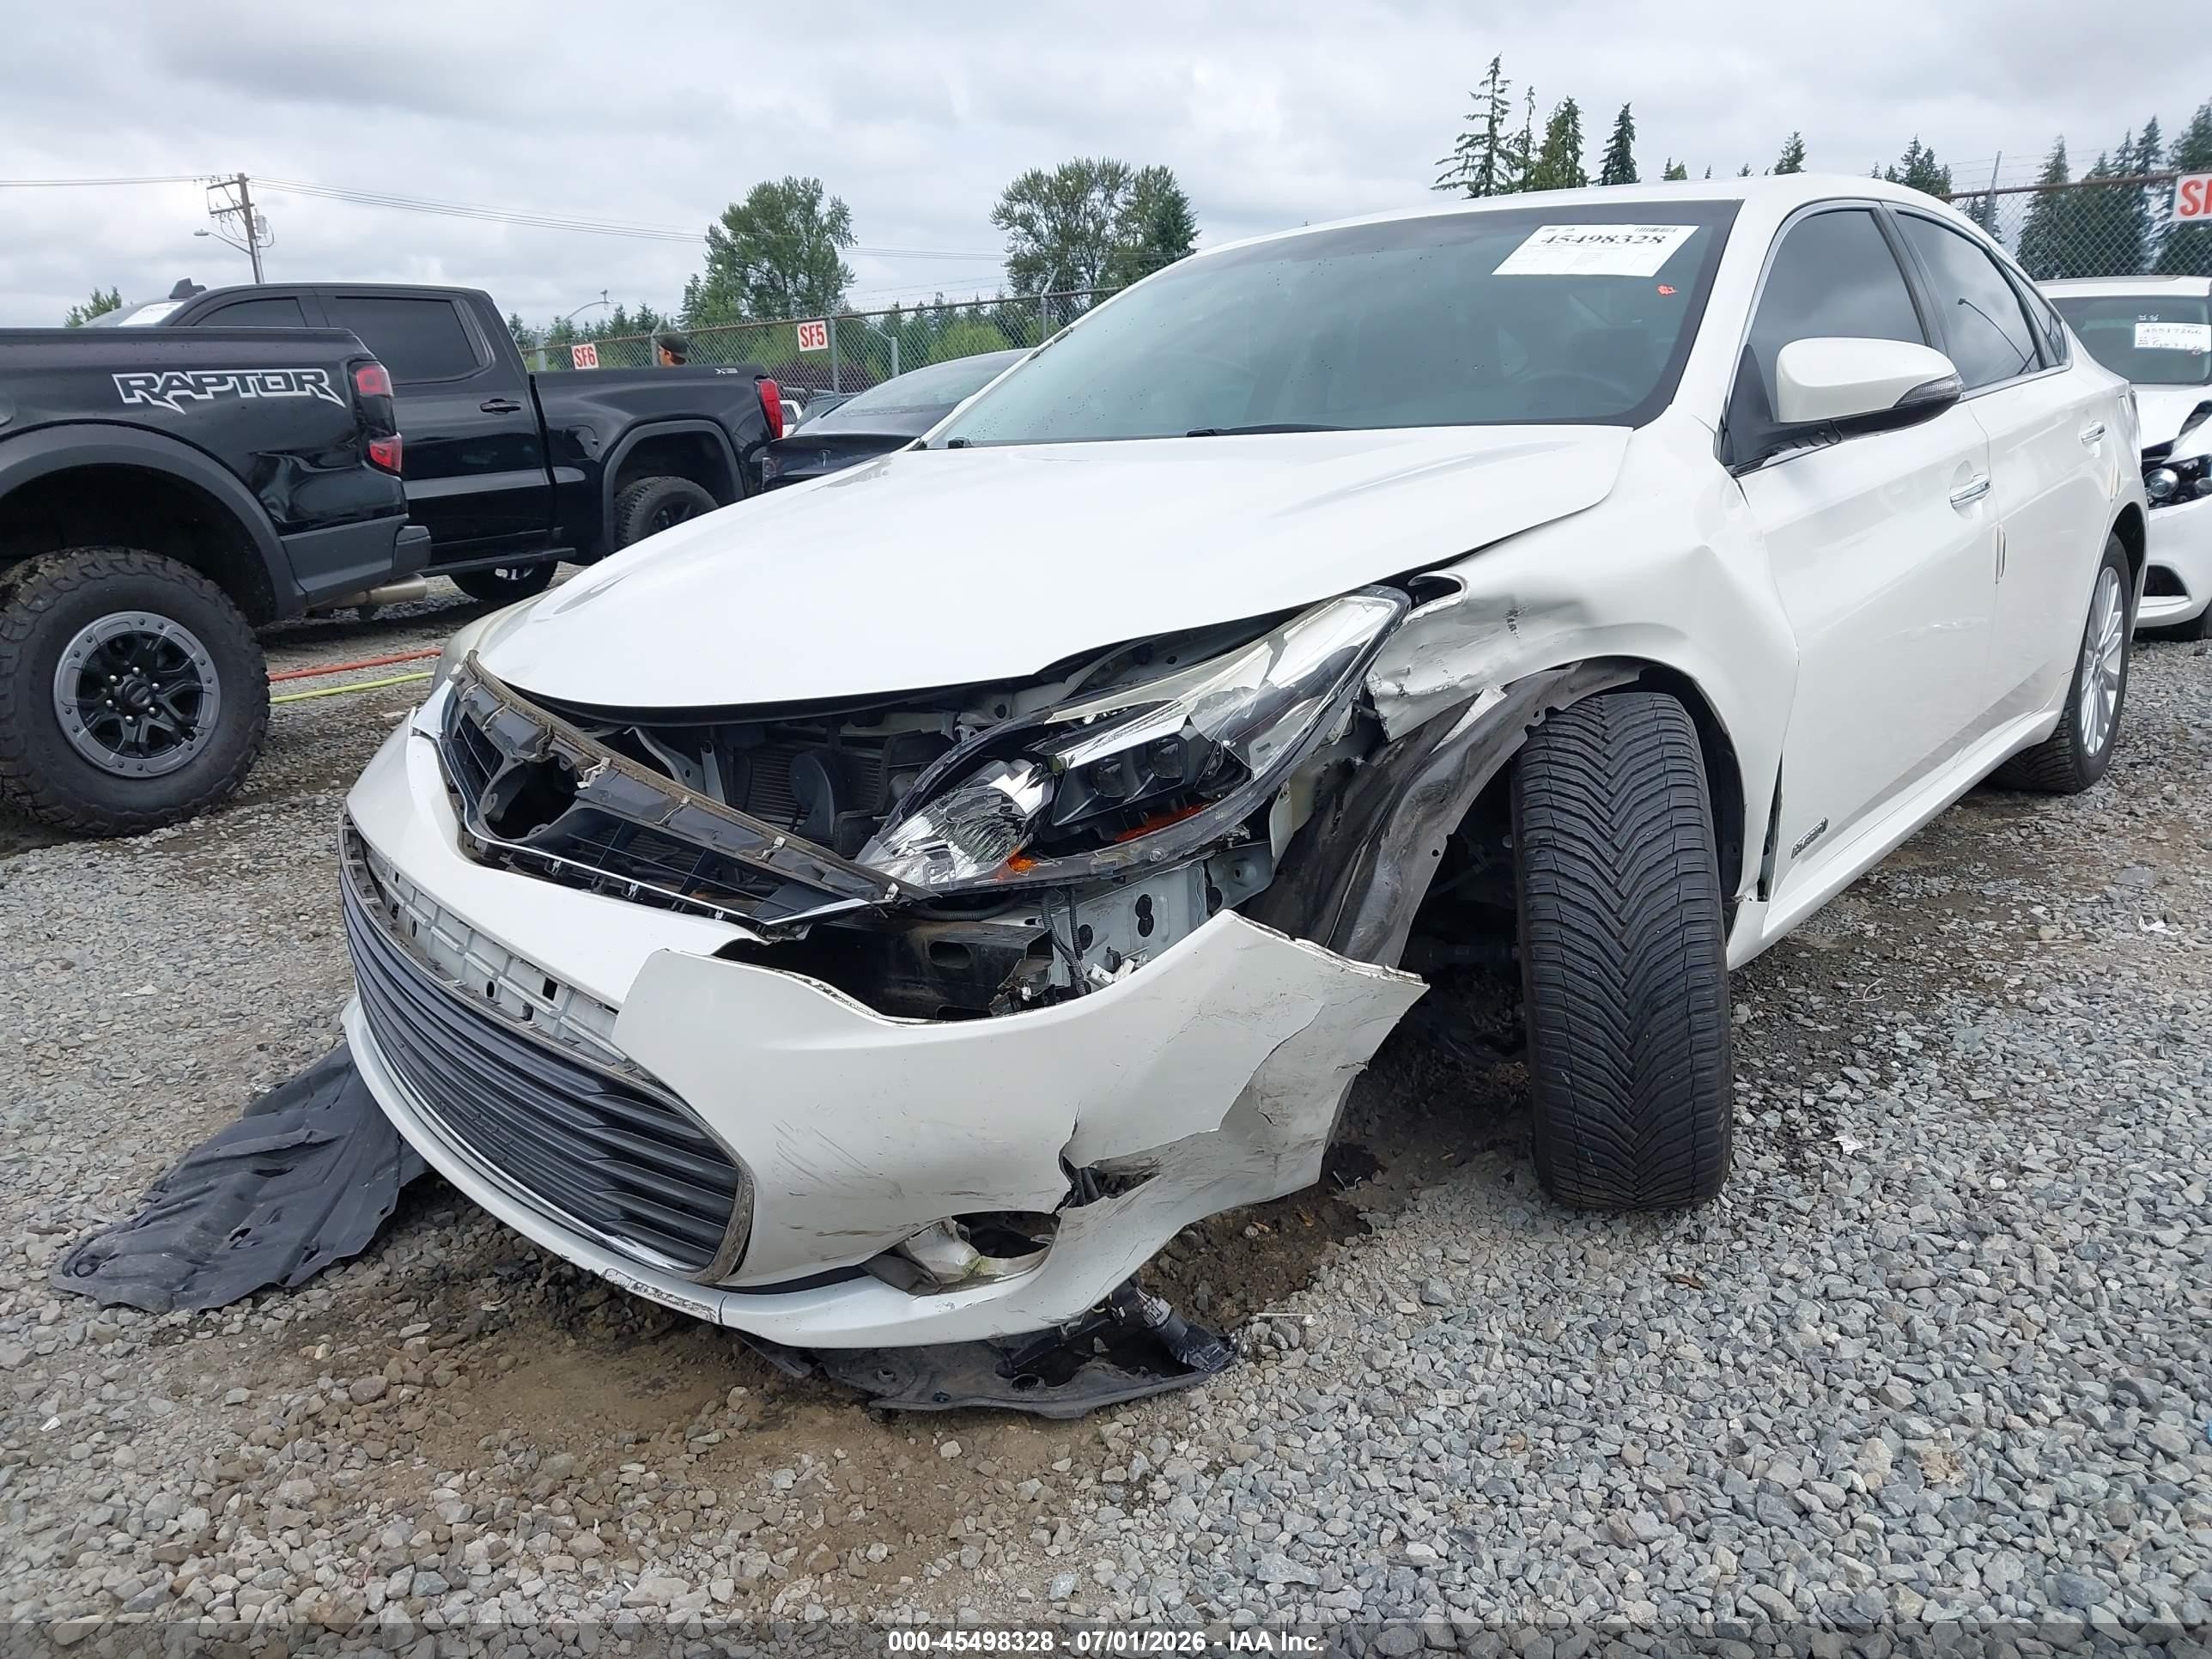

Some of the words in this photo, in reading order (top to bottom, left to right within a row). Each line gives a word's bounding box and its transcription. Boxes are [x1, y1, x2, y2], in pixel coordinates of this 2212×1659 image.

[1541, 234, 1667, 245] 45498328
[799, 324, 826, 349] SF5
[574, 349, 597, 368] SF6
[112, 368, 345, 415] RAPTOR
